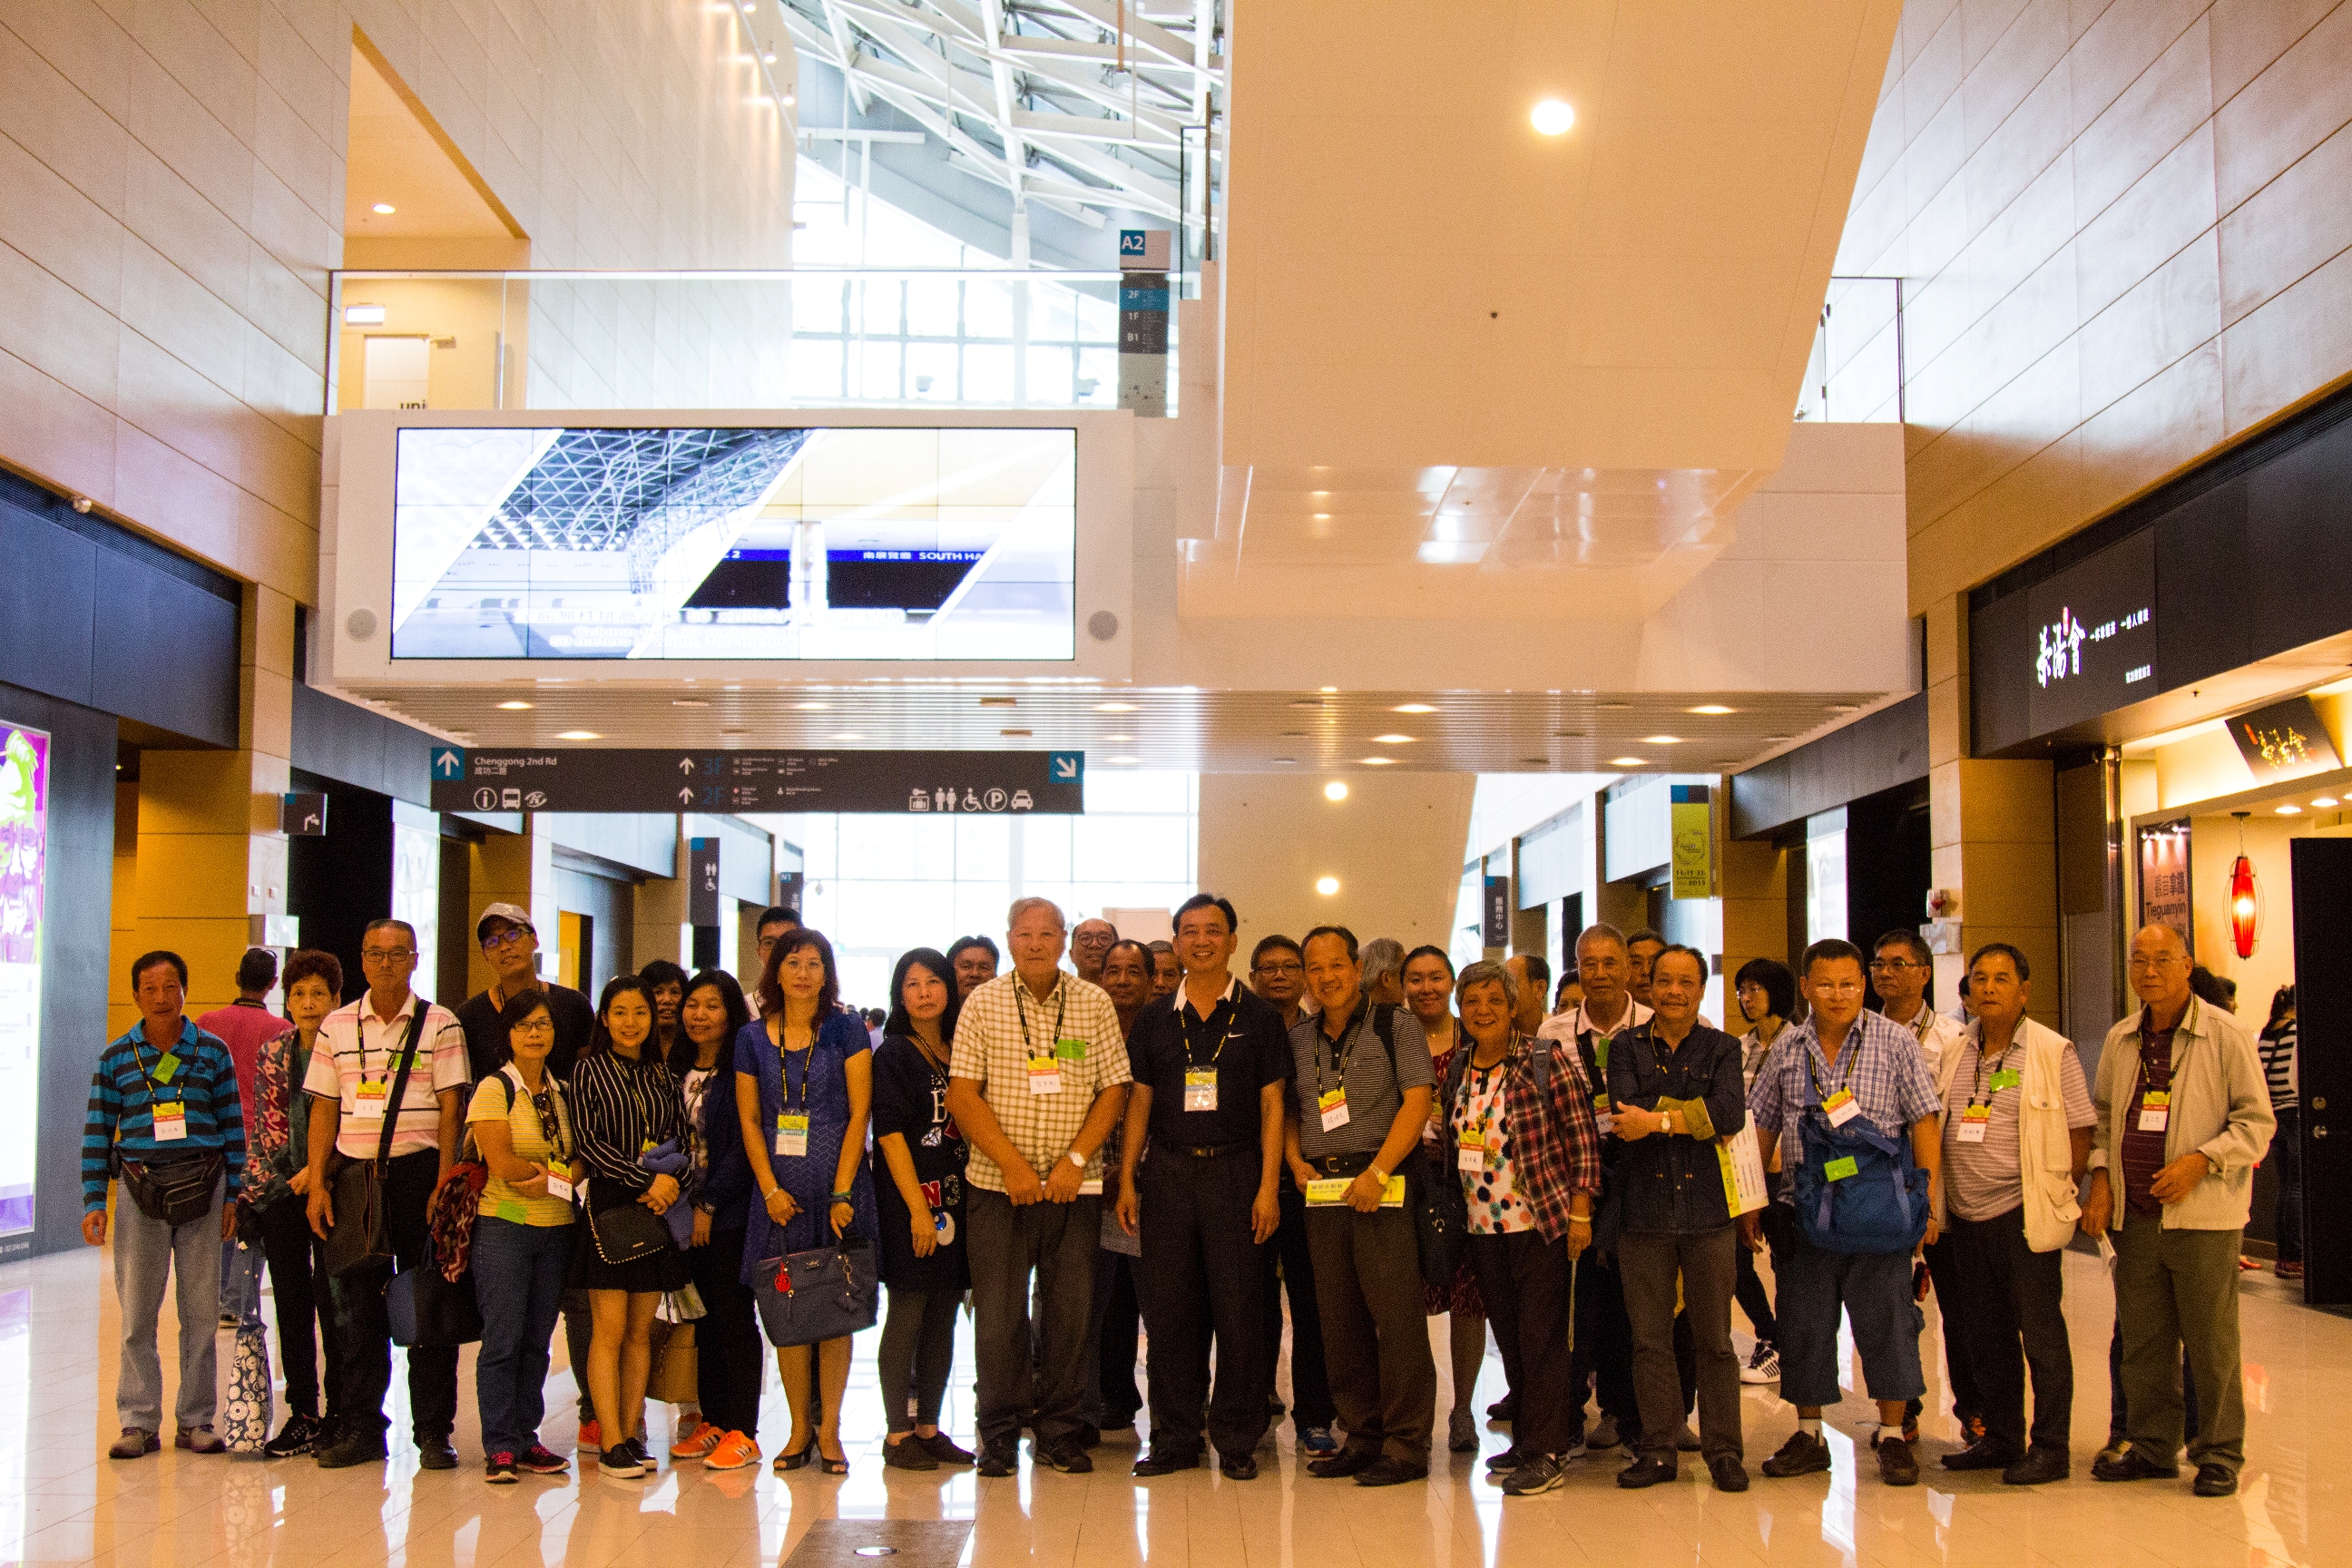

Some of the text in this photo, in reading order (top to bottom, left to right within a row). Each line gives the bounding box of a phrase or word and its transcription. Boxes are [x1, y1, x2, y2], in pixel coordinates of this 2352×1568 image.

[1122, 235, 1144, 250] A2
[1127, 333, 1139, 342] B1
[919, 552, 962, 561] SOUTH
[474, 757, 558, 768] Chenggong 2nd Rd
